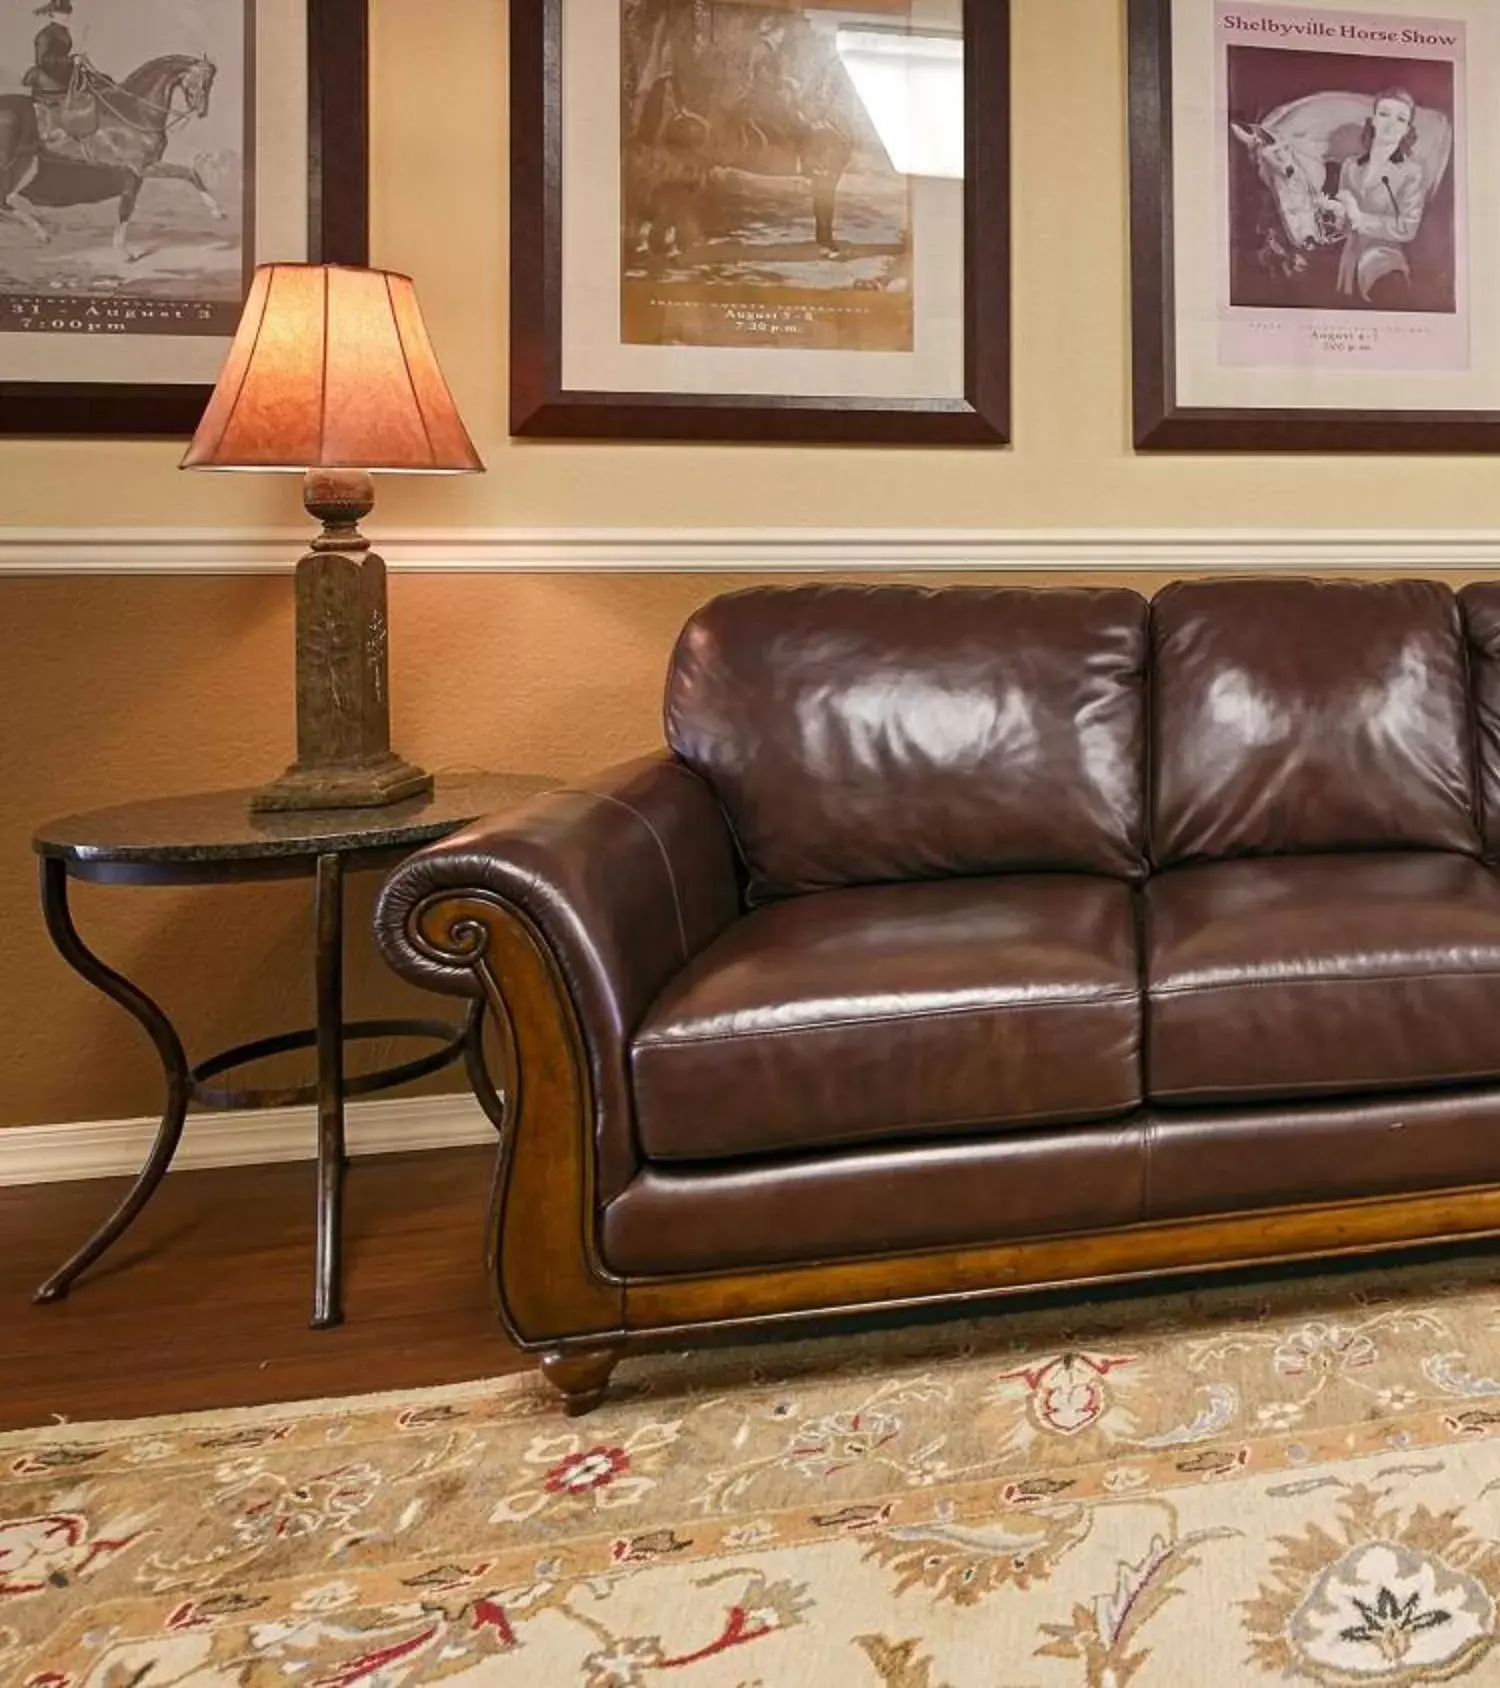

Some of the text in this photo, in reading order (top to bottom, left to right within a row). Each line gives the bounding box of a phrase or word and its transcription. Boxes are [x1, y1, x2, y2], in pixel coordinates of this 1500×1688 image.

[1223, 15, 1457, 46] Shelbyville Horse Show
[86, 305, 184, 319] August
[724, 309, 777, 321] August
[1312, 329, 1353, 341] August
